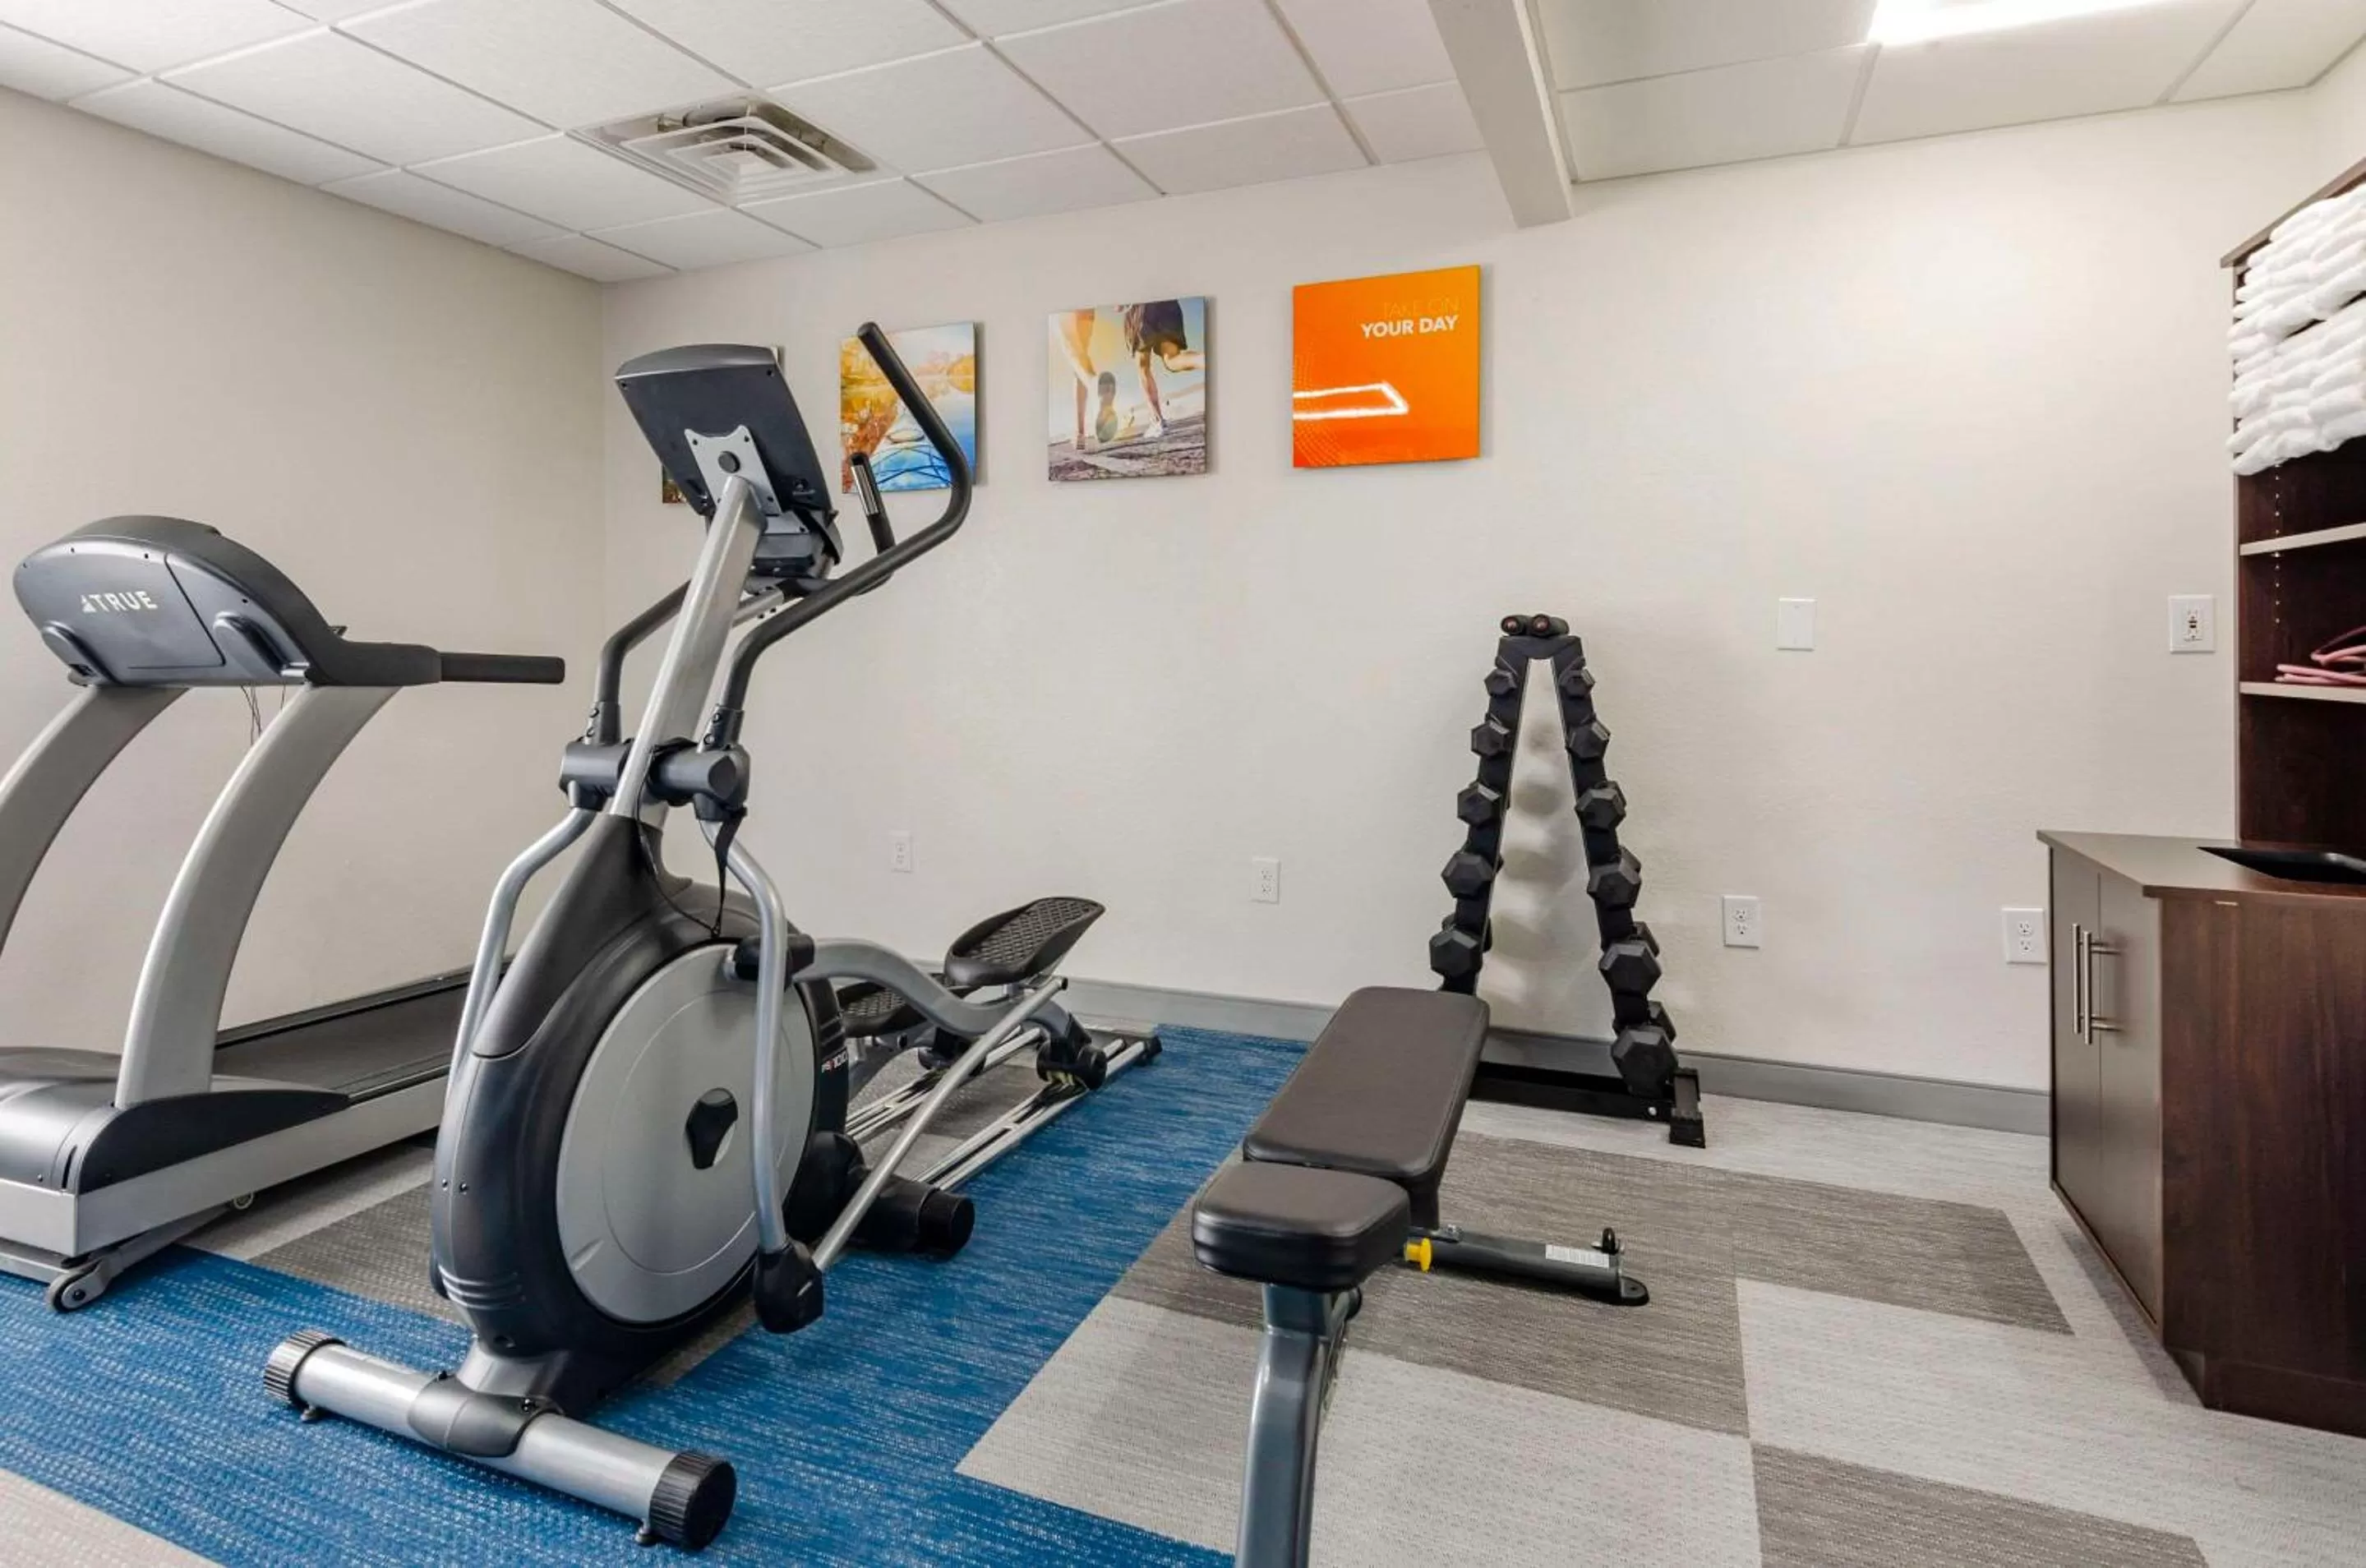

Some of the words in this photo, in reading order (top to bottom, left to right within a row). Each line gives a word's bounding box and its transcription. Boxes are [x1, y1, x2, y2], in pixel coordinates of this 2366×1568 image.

[1361, 319, 1414, 339] YOUR
[1419, 315, 1459, 334] DAY
[88, 591, 158, 612] TRUE
